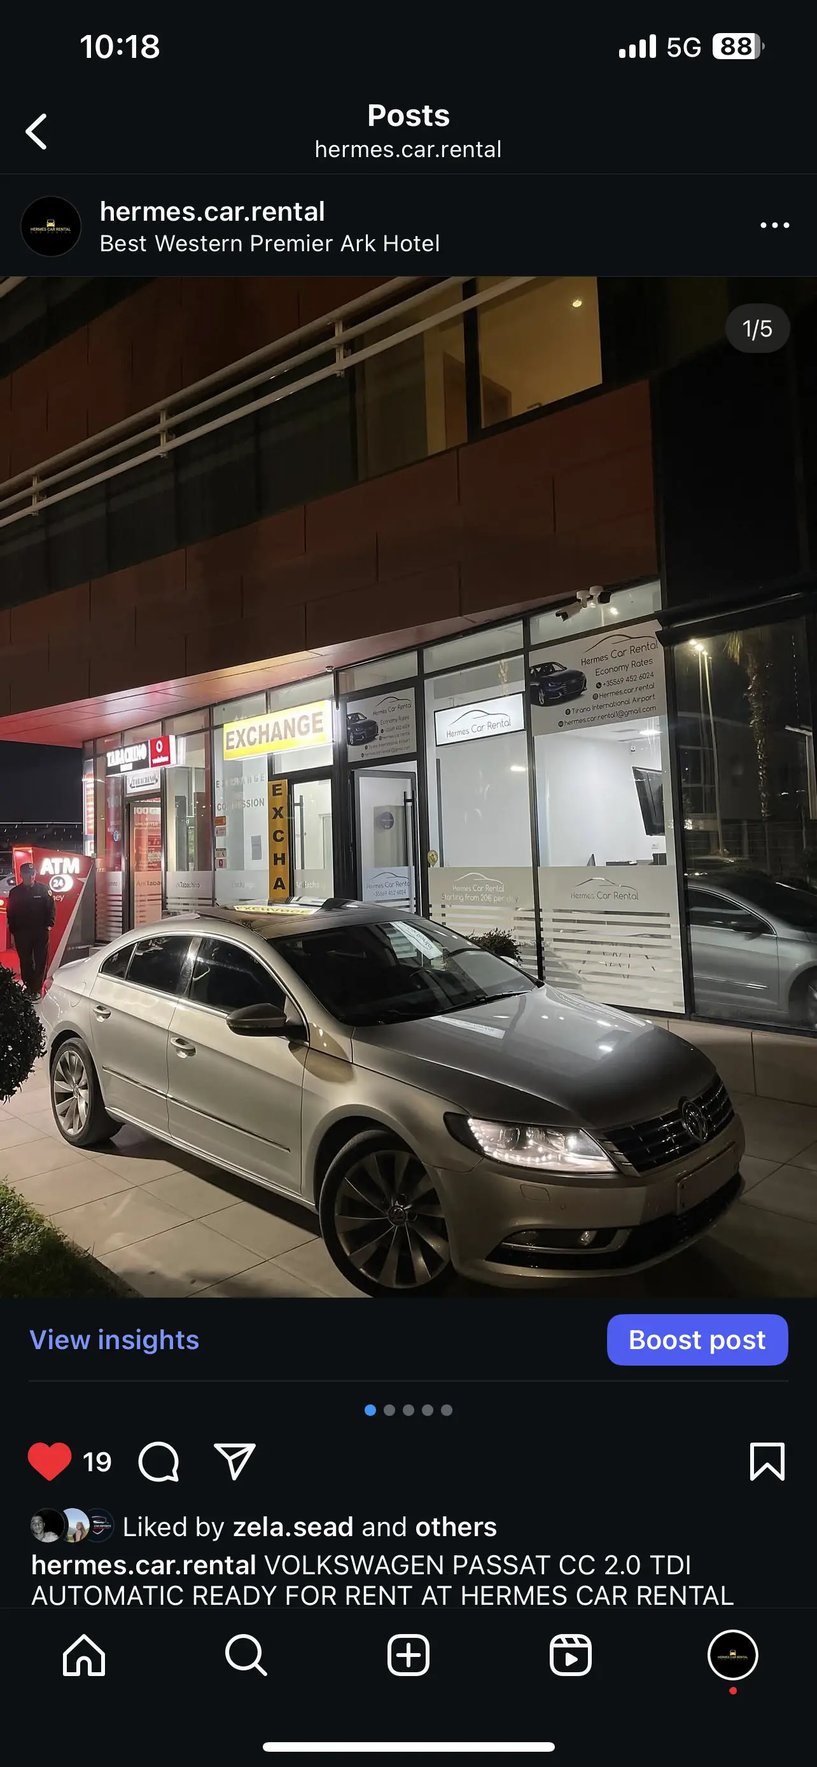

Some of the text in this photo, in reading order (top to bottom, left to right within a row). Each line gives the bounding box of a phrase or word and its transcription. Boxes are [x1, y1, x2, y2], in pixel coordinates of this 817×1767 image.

[581, 640, 658, 666] Hermes Car Rental
[595, 658, 654, 677] Economy Rates
[225, 711, 324, 750] EXCHANGE
[446, 719, 512, 738] Hermes Car Rental
[40, 857, 80, 875] ATM
[52, 879, 64, 888] 24
[597, 891, 611, 899] Car
[613, 889, 639, 900] Rental
